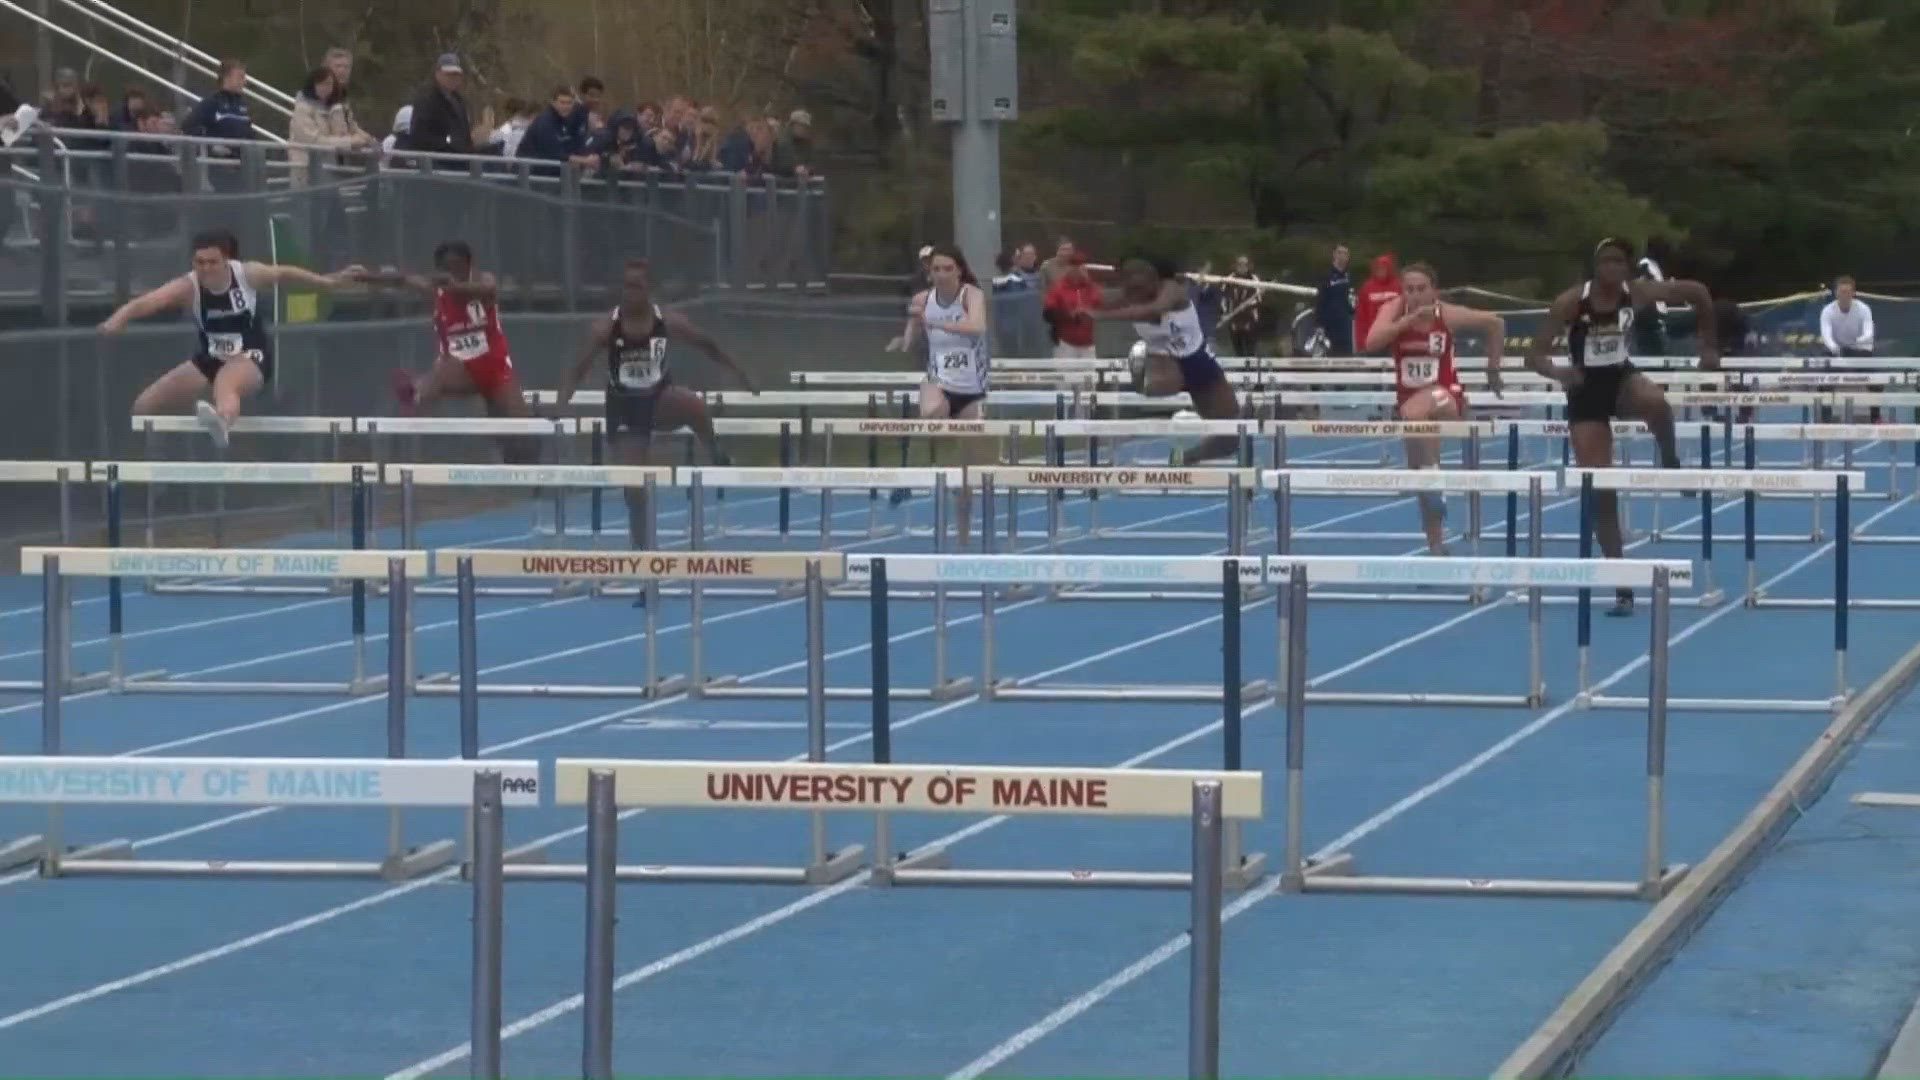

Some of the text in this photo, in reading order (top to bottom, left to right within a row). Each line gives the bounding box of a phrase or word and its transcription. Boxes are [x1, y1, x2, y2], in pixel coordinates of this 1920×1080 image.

[233, 289, 246, 309] 8
[1433, 334, 1443, 353] 3
[859, 423, 985, 433] UNIVERSITY OF MAINE
[1312, 423, 1441, 434] UNIVERSITY OF MAINE
[1028, 471, 1193, 485] UNIVERSITY OF MAINE
[110, 555, 340, 574] UNIVERSITY OF MAINE
[522, 556, 755, 576] UNIVERSITY OF MAINE
[936, 560, 1058, 578] UNIVERSITY
[1064, 560, 1090, 578] OF
[1489, 563, 1515, 580] OF
[1528, 563, 1598, 582] MAINE
[0, 766, 382, 799] NIVERSITY OF MAINE
[706, 773, 1108, 808] UNIVERSITY OF MAINE
